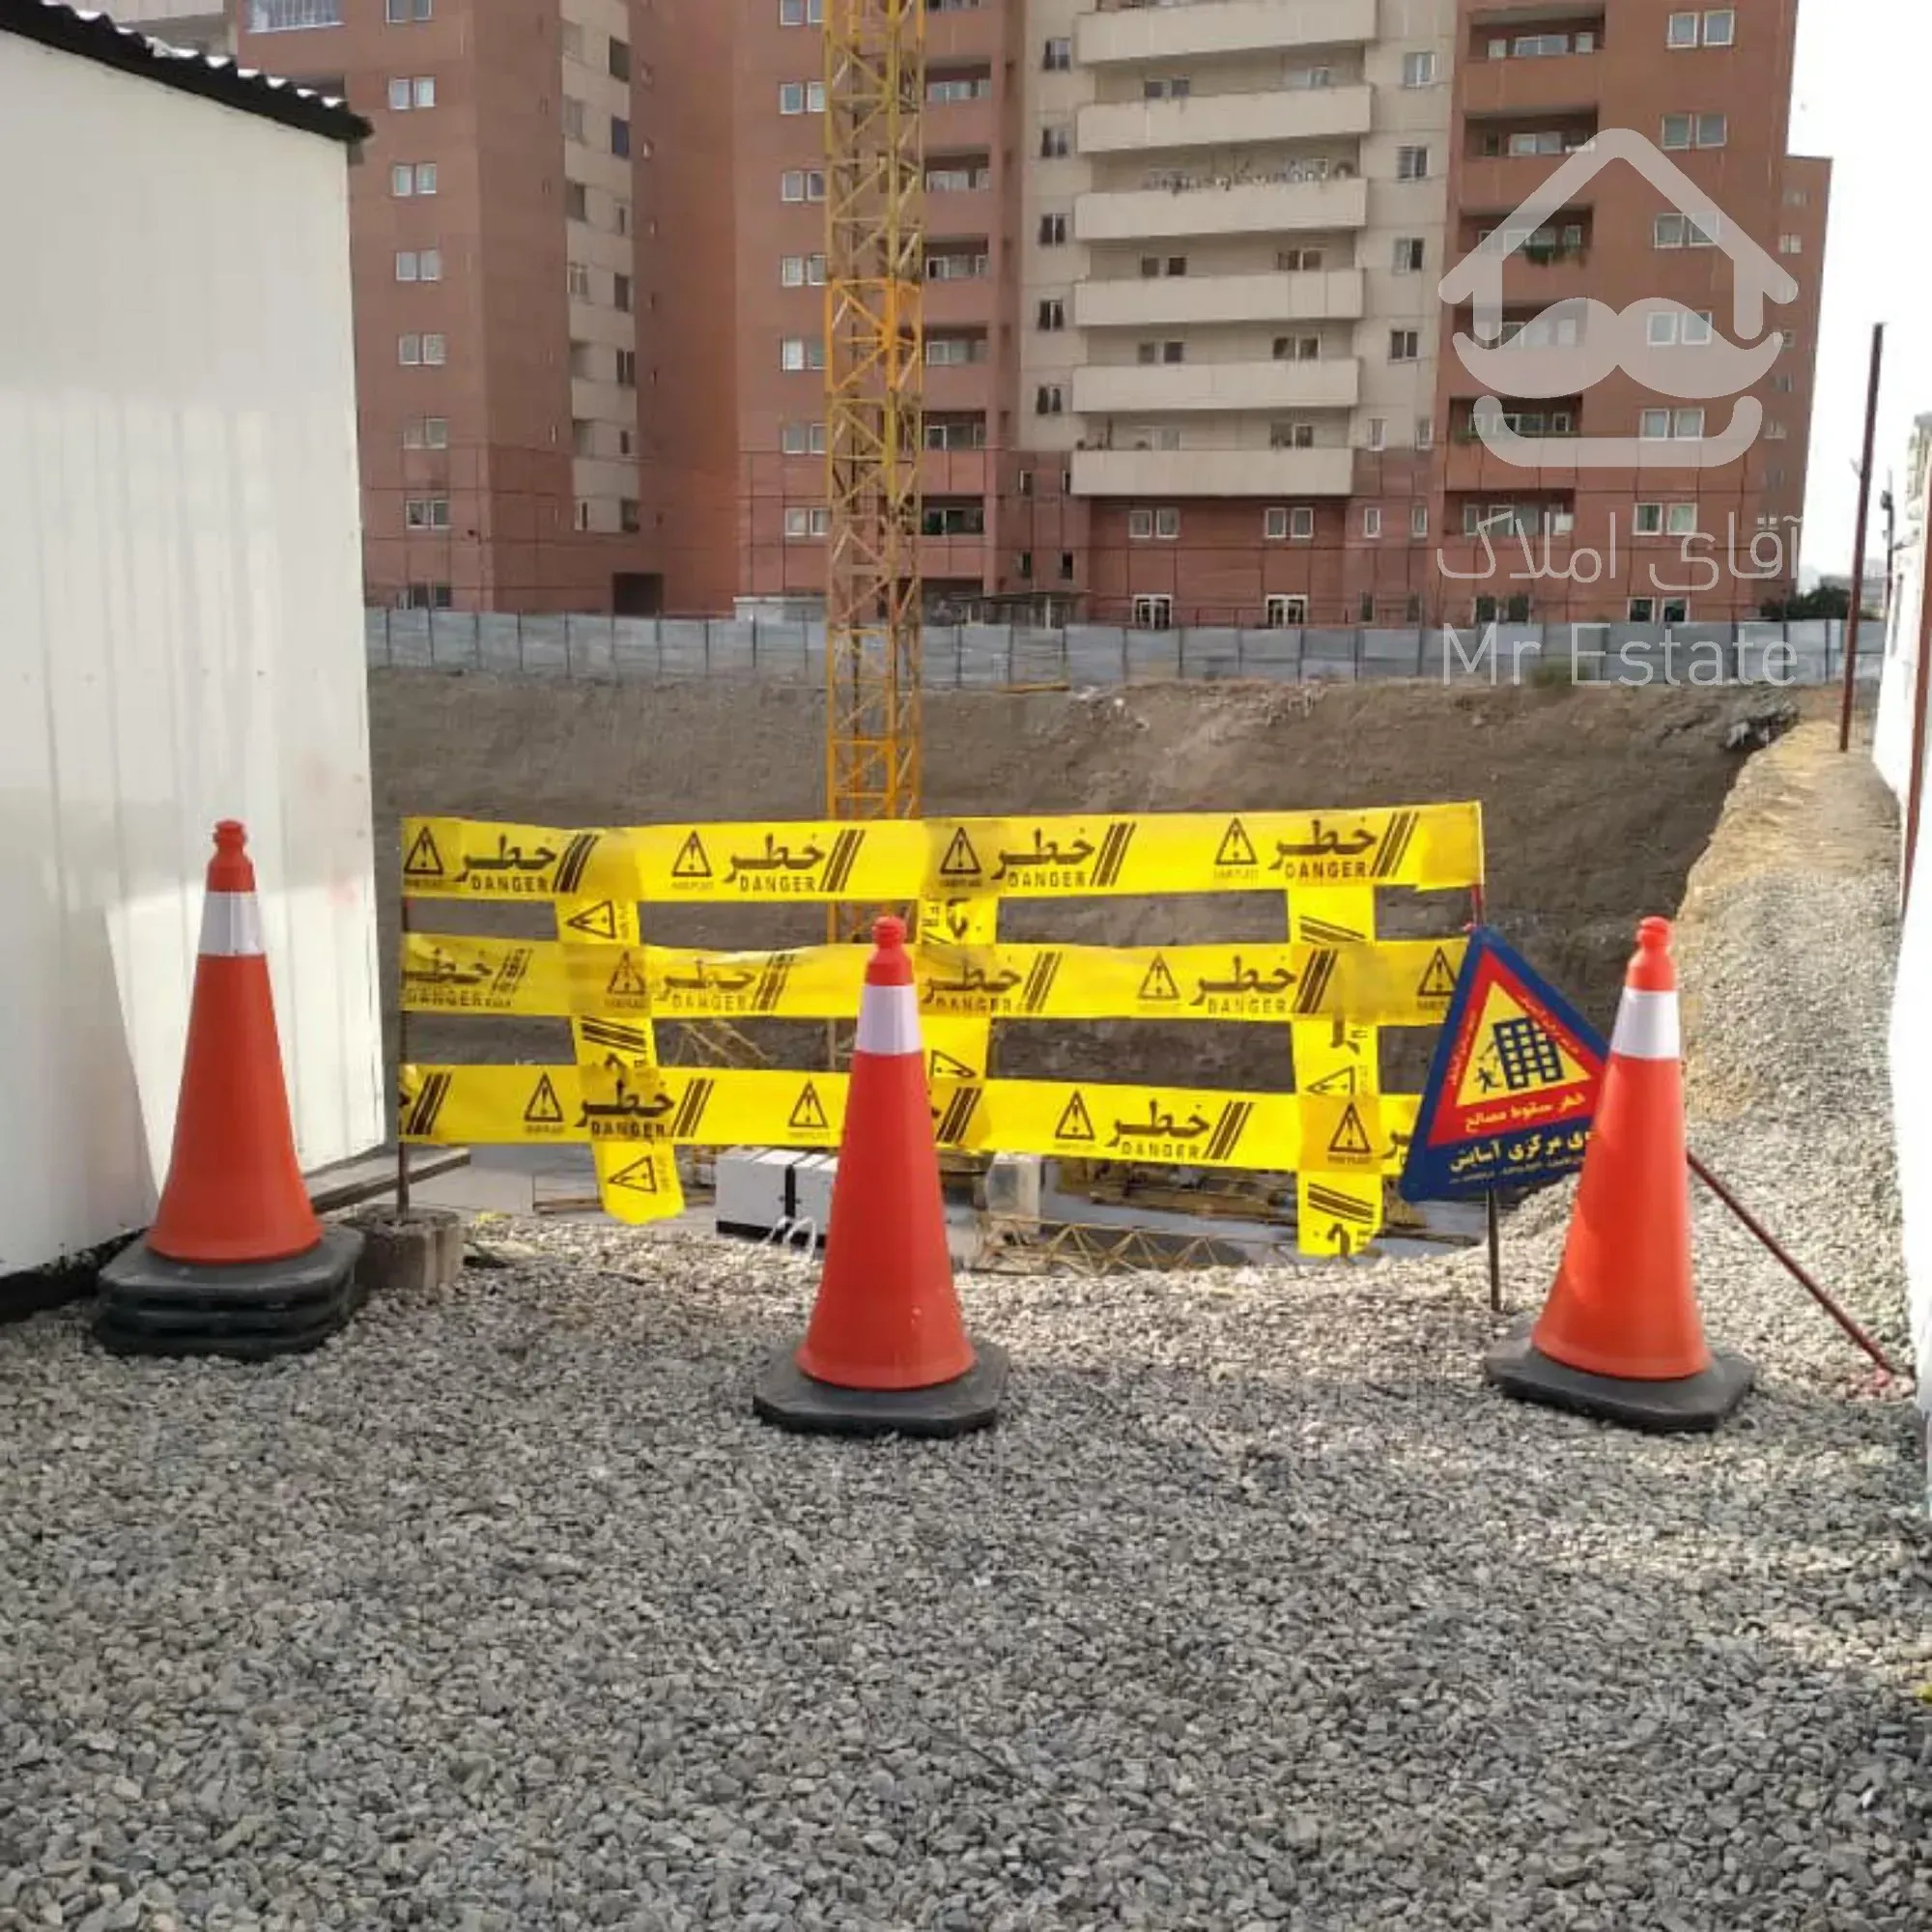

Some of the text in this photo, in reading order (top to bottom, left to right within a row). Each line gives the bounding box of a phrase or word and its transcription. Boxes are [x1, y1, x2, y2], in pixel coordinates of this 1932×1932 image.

[454, 833, 557, 883] خطر
[720, 832, 826, 885] خطر
[990, 829, 1095, 880] خطر
[1268, 816, 1378, 870] خطر
[471, 874, 549, 891] DANGER
[737, 875, 816, 893] DANGER
[1008, 870, 1087, 888] DANGER
[1285, 861, 1372, 879] DANGER
[921, 954, 1022, 1005] خطر
[1189, 954, 1296, 1007] خطر
[1208, 997, 1288, 1014] DANGER
[574, 1079, 675, 1128] خطر
[1104, 1097, 1210, 1148] خطر
[590, 1121, 667, 1138] DANGER
[1121, 1140, 1201, 1160] DANGER
